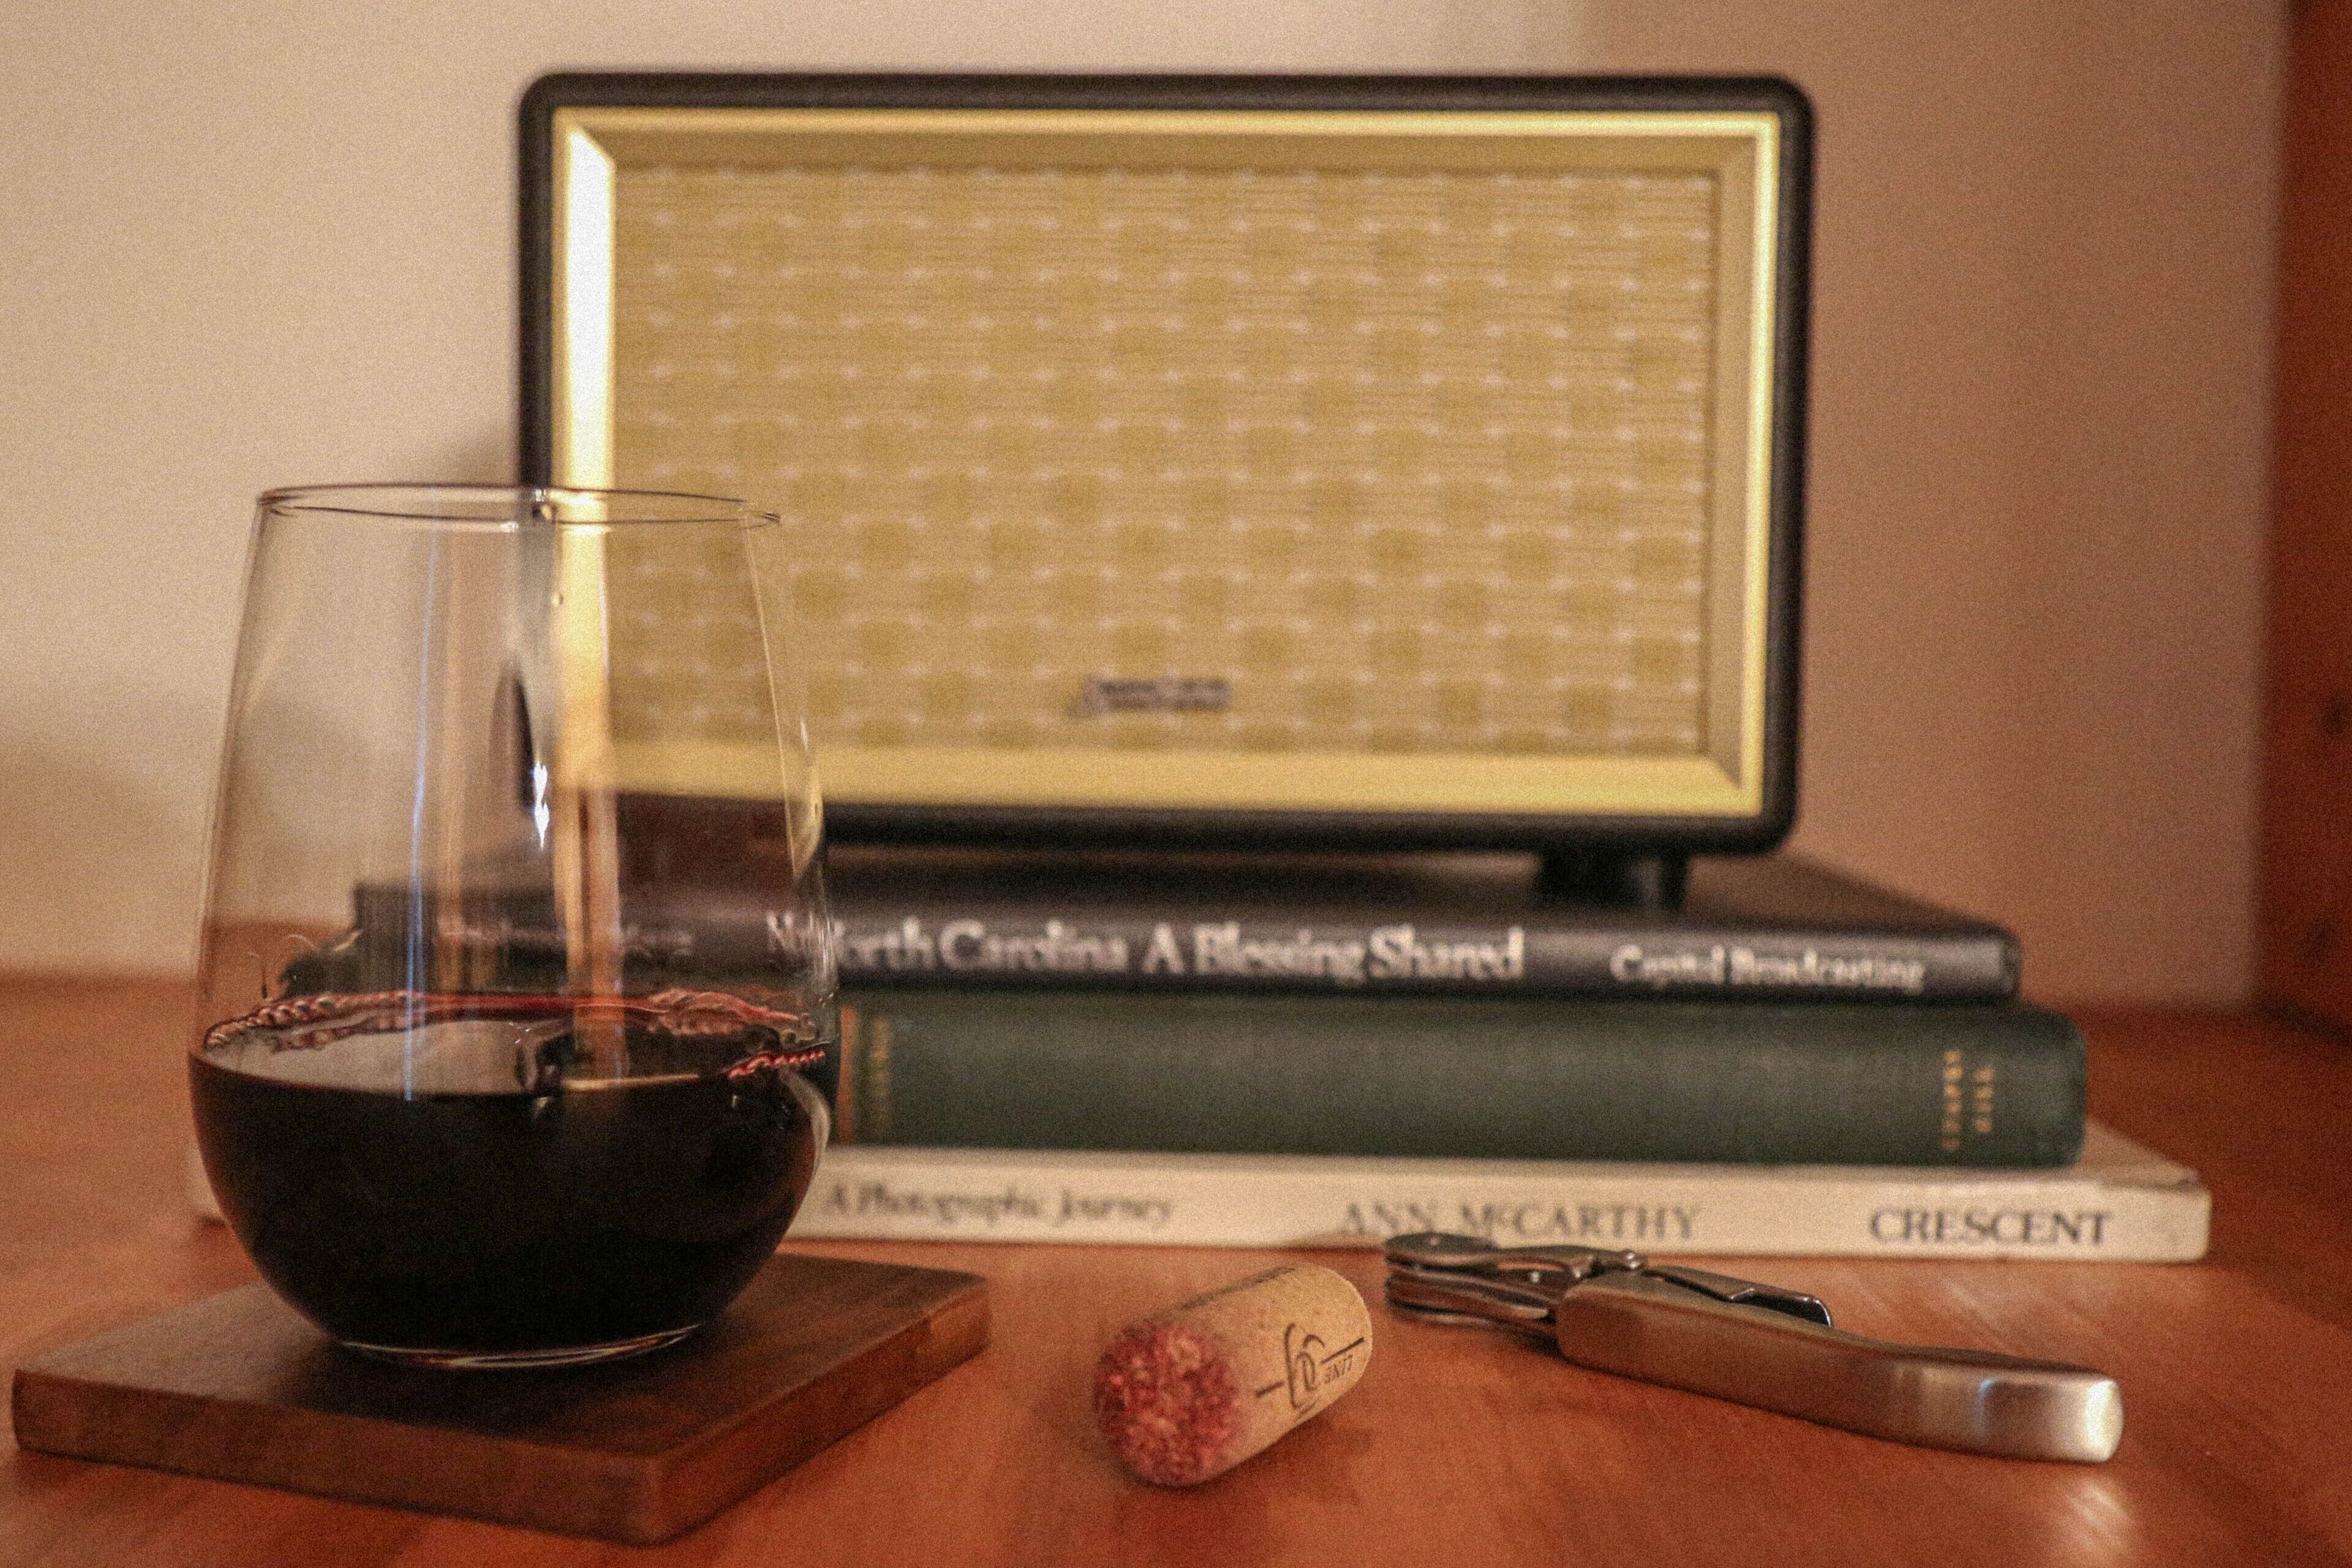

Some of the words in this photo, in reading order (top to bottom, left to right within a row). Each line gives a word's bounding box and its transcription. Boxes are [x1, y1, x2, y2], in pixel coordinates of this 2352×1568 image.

[940, 919, 1129, 974] Carolina
[1142, 921, 1184, 975] A
[1193, 921, 1365, 987] Blessing
[1370, 922, 1525, 979] Shared
[1610, 944, 1725, 988] Capital
[1730, 947, 1924, 995] Broadcasting
[856, 1182, 1041, 1226] Photographic
[1052, 1187, 1172, 1229] Journey
[1343, 1201, 1436, 1235] ANN
[1869, 1207, 2114, 1245] CRESCENT
